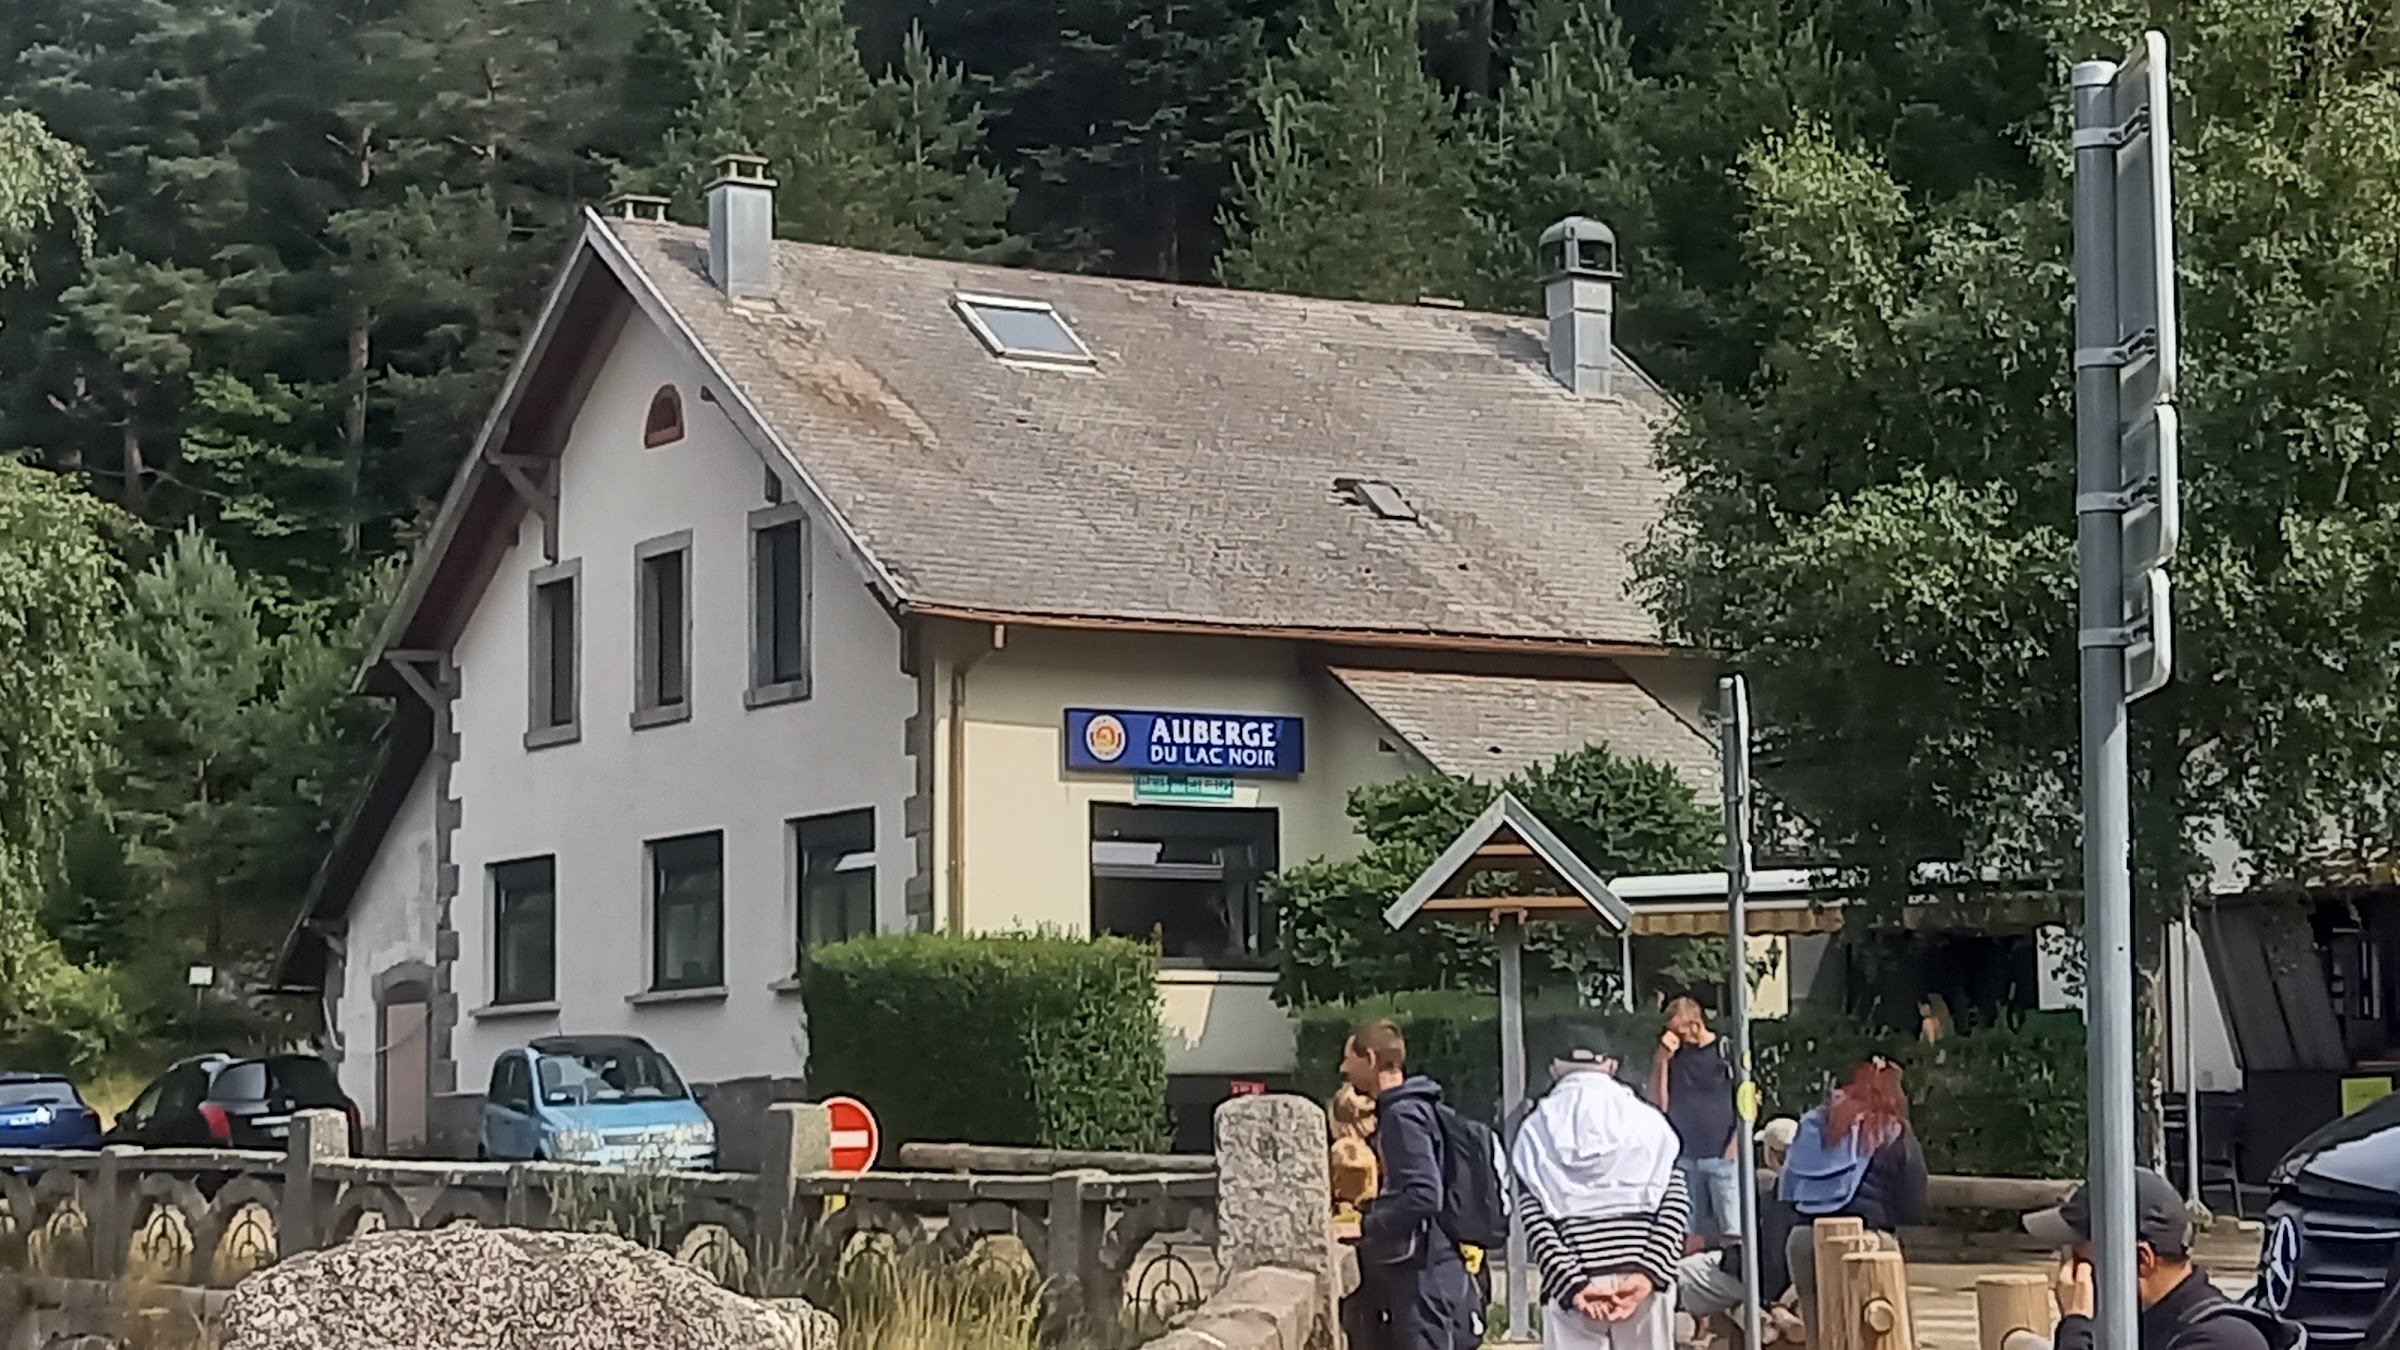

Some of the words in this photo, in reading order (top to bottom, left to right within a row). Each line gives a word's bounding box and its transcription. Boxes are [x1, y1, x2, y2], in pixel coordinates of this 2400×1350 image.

[1151, 717, 1277, 747] AUBERGE
[1151, 744, 1178, 762] DU
[1184, 746, 1223, 764] LAC
[1228, 747, 1275, 766] NOIR
